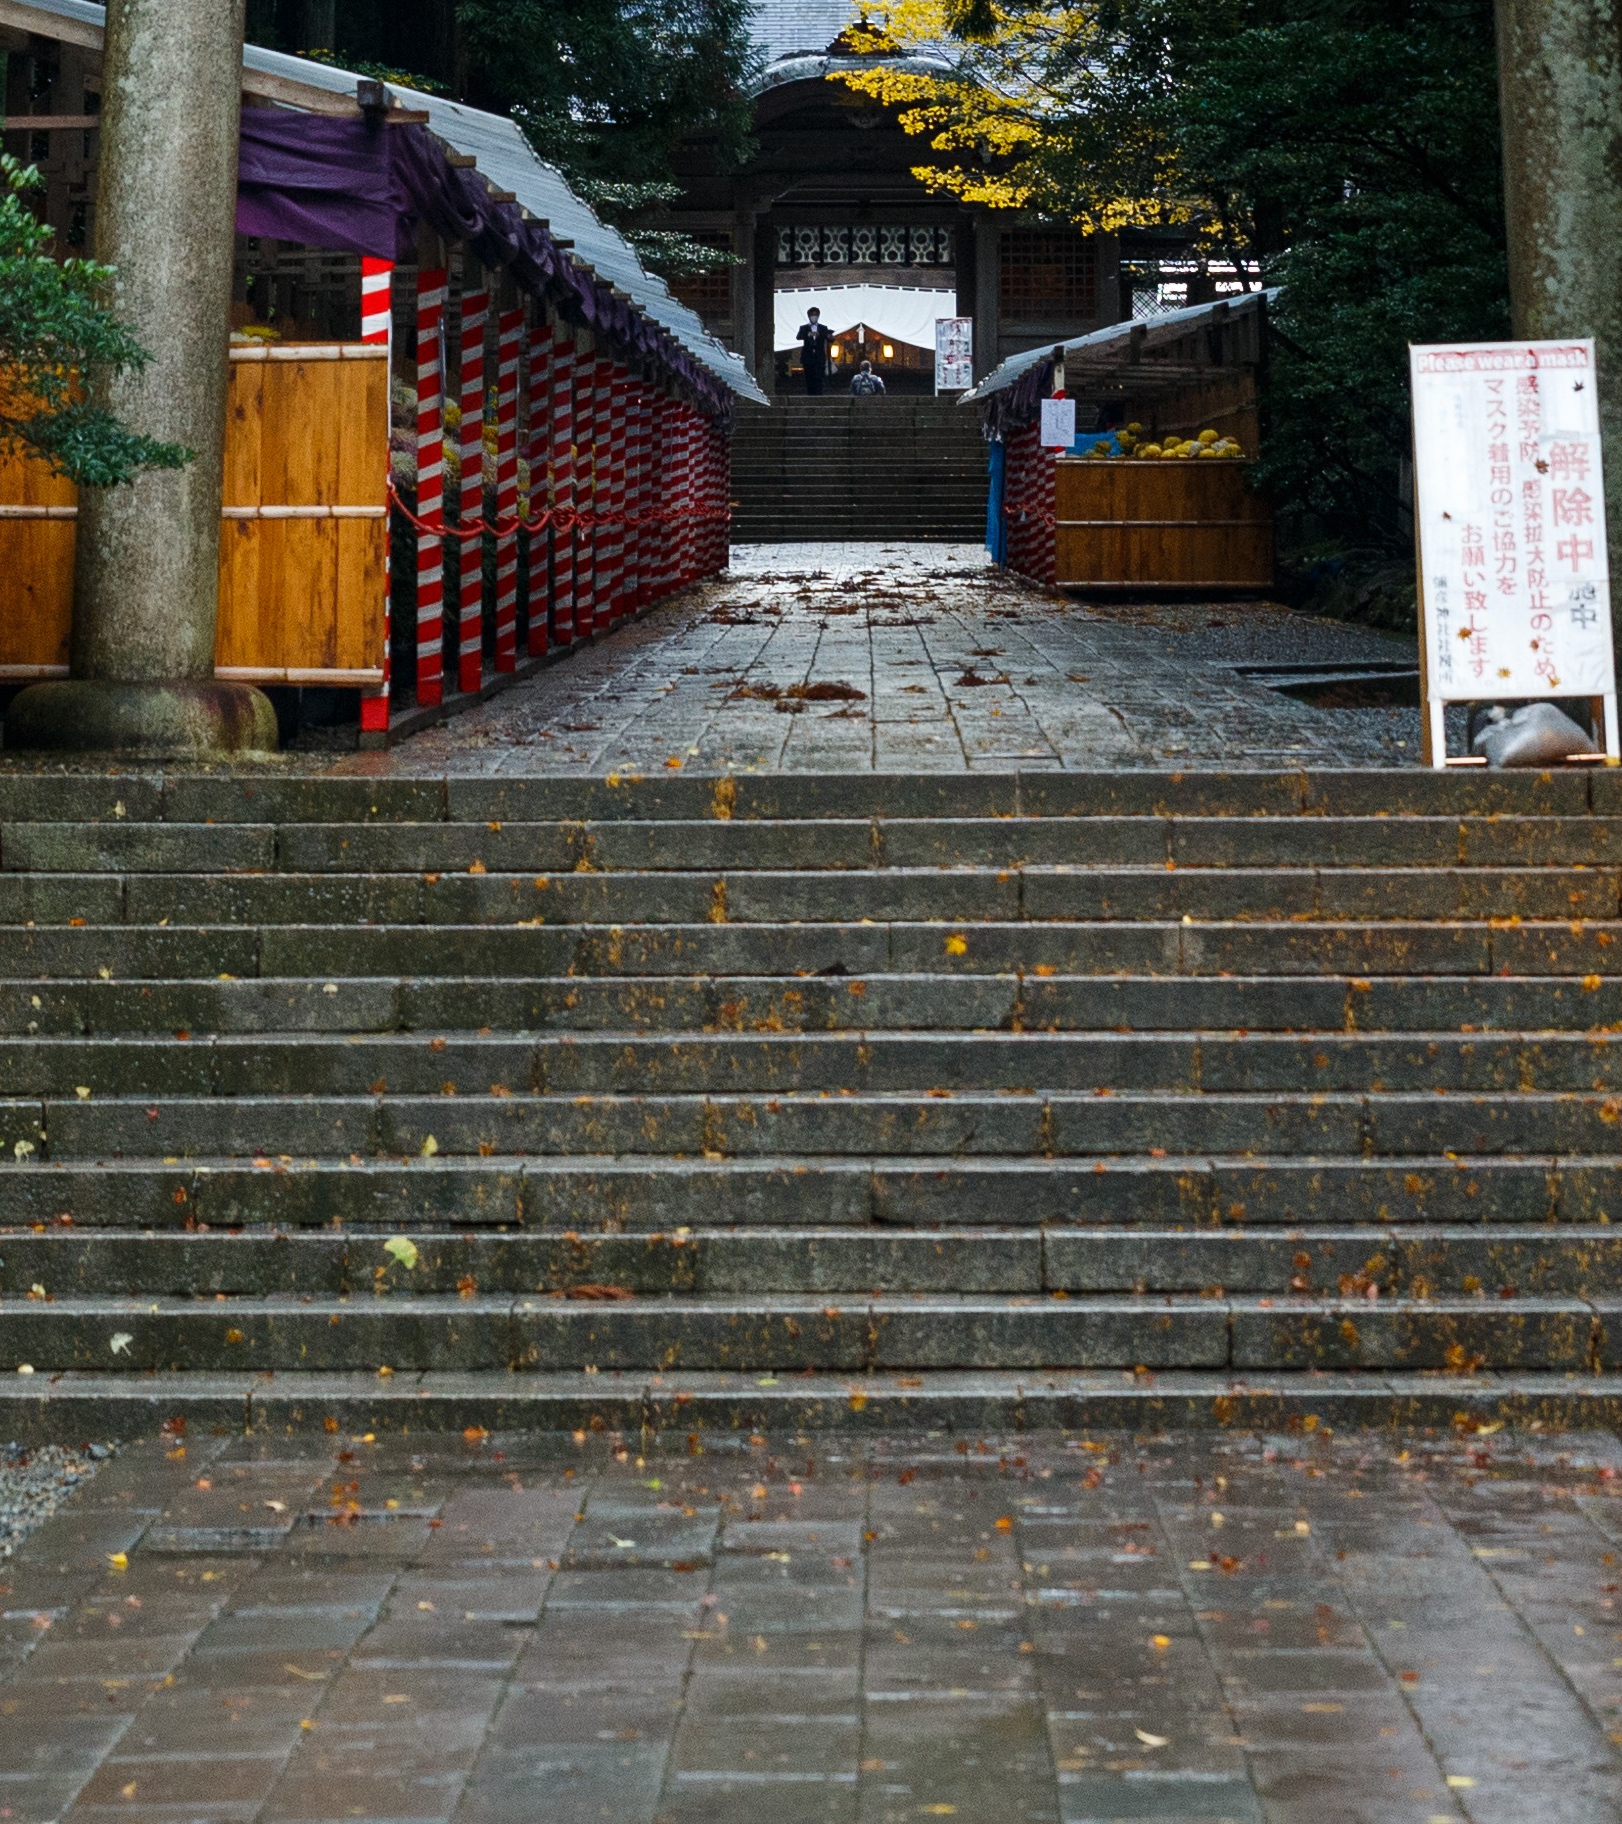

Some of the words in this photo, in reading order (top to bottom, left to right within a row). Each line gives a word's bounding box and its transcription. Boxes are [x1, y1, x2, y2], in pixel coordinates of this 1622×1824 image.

[1417, 354, 1475, 372] Please
[1478, 355, 1524, 370] wear
[1539, 352, 1587, 367] mask
[1548, 441, 1594, 573] 解除中
